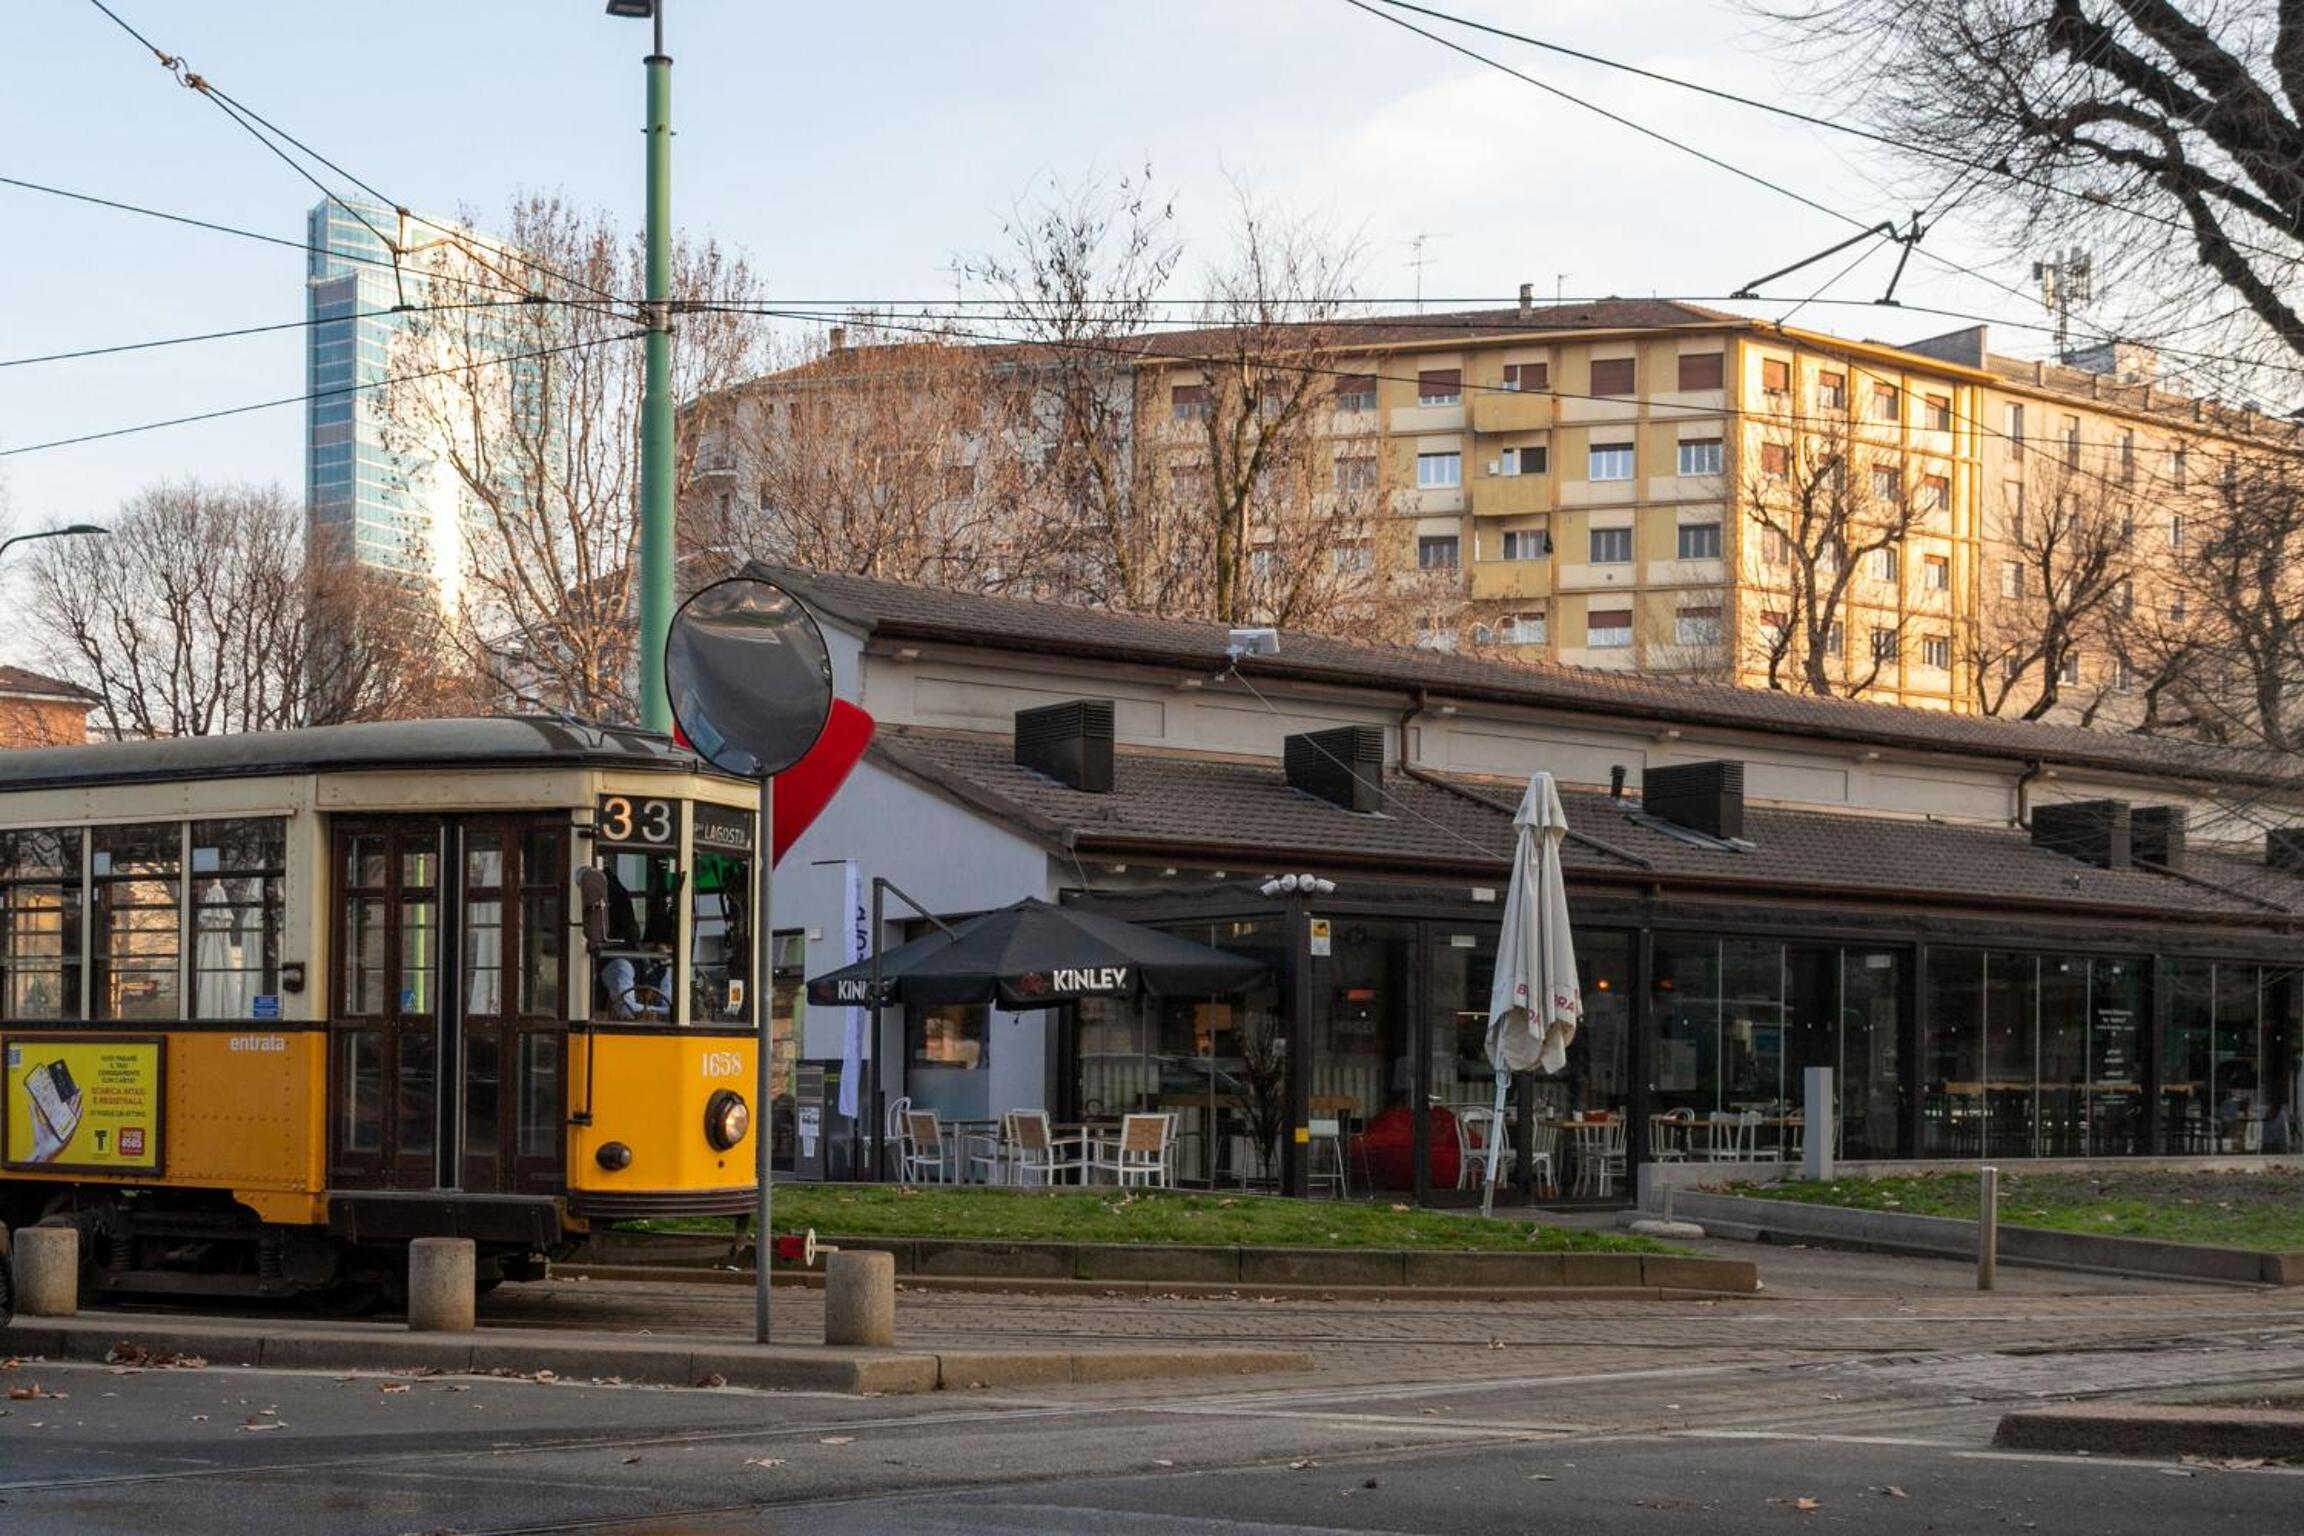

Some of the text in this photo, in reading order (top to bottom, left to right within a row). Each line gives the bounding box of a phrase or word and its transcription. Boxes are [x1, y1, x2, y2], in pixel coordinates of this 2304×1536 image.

[602, 796, 672, 843] 33
[230, 1033, 285, 1051] entrata
[701, 1051, 742, 1077] 1658
